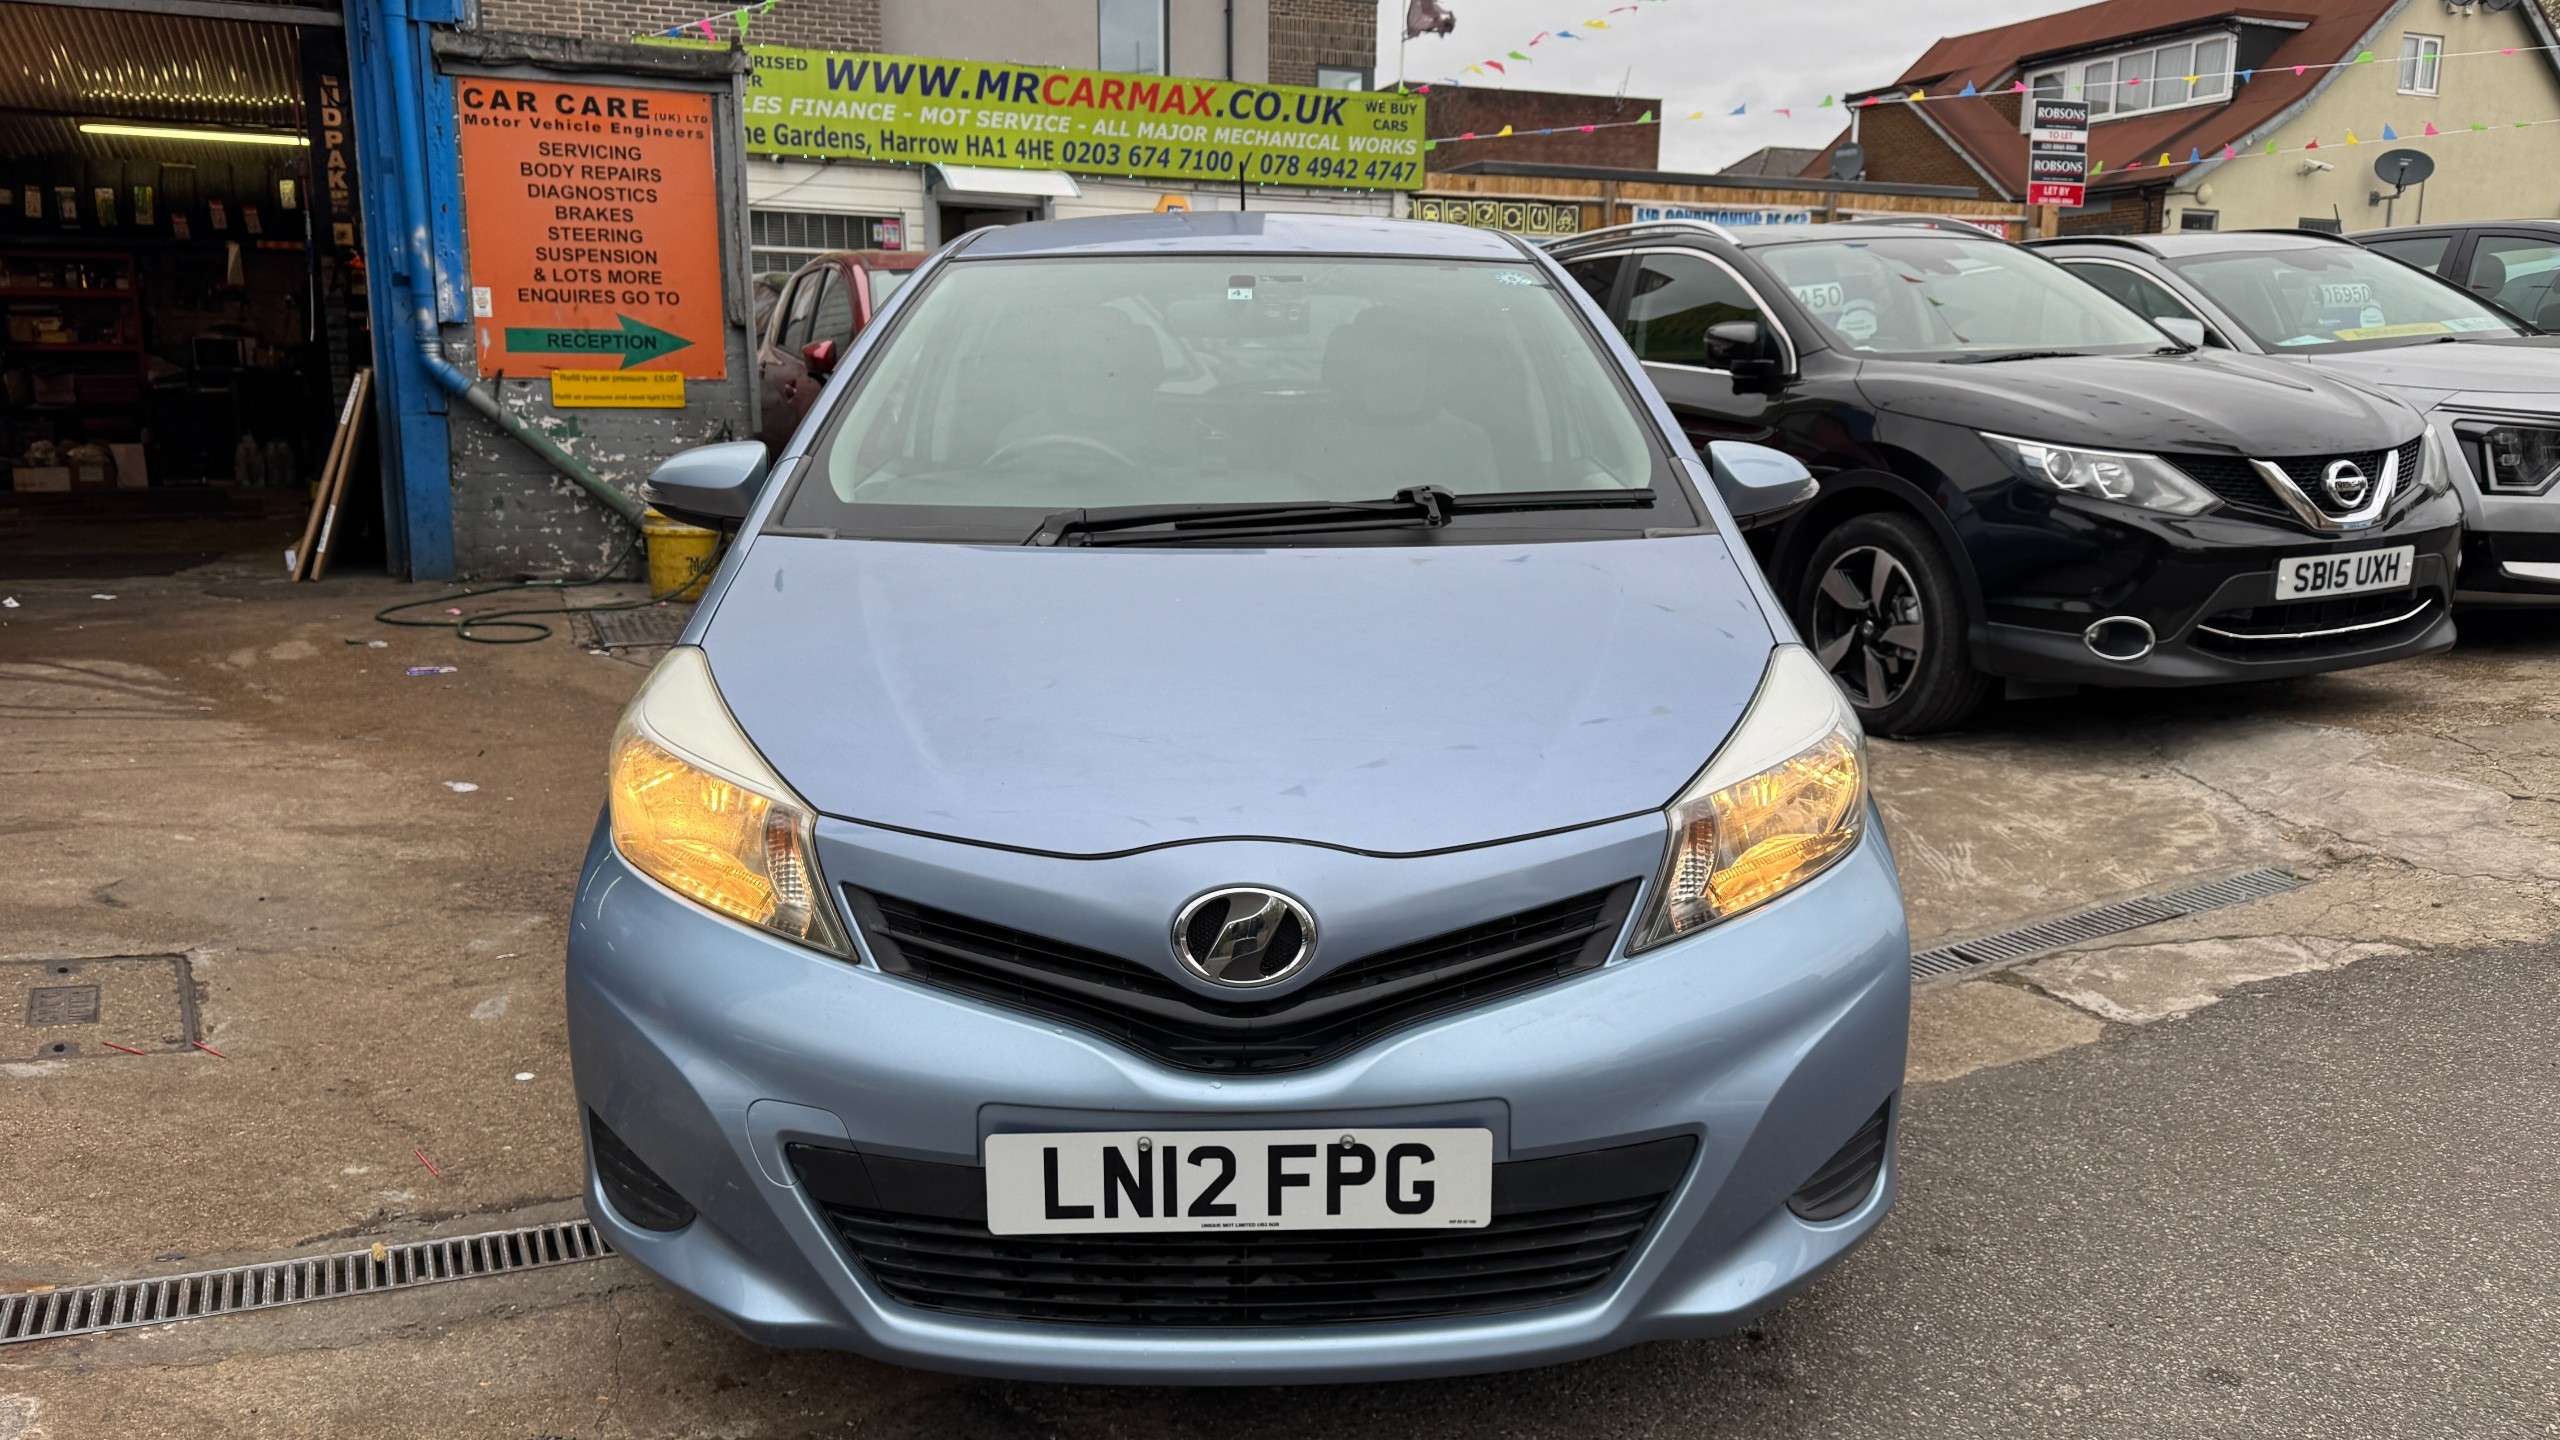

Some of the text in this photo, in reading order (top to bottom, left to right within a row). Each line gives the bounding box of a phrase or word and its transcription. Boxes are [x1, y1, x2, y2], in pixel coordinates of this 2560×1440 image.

[746, 74, 763, 88] R
[826, 57, 1348, 126] WWW.MRCARMAX.CO.UK
[463, 87, 708, 125] CAR CARE (UK) LTD
[1365, 102, 1417, 115] WE BUY
[2037, 107, 2086, 120] ROBSONS
[464, 113, 705, 140] Motor Vehicle Engineers
[789, 98, 896, 121] FINANCE
[920, 106, 971, 126] MOT
[976, 110, 1072, 133] SERVICE
[1092, 119, 1131, 138] ALL
[1137, 121, 1207, 143] MAJOR
[1213, 126, 1341, 151] MECHANICAL
[1348, 135, 1418, 155] WORKS
[1373, 119, 1408, 132] CARS
[2049, 131, 2073, 140] TO LET
[538, 141, 642, 161] SERVICING
[773, 123, 872, 154] Gardens,
[880, 129, 958, 155] Harrow
[966, 134, 1006, 158] HA1
[1015, 137, 1055, 161] 4HE
[1062, 140, 1120, 166] 0203
[1128, 146, 1170, 169] 674
[1179, 149, 1233, 172] 7100
[1260, 153, 1299, 176] 078
[1307, 156, 1358, 179] 4942
[1365, 160, 1417, 182] 4747
[520, 162, 662, 183] BODY REPAIRS
[2033, 159, 2083, 173] ROBSONS
[527, 183, 658, 203] DIAGNOSTICS
[2043, 186, 2071, 197] LET BY
[555, 205, 634, 222] BRAKES
[548, 226, 643, 243] STEERING
[535, 247, 658, 264] SUSPENSION
[533, 267, 662, 285] & LOTS MORE
[518, 287, 680, 306] ENQUIRES GO TO
[547, 333, 657, 350] RECEPTION
[2293, 554, 2400, 592] SB15 UXH
[1043, 1143, 1436, 1220] LN12 FPG
